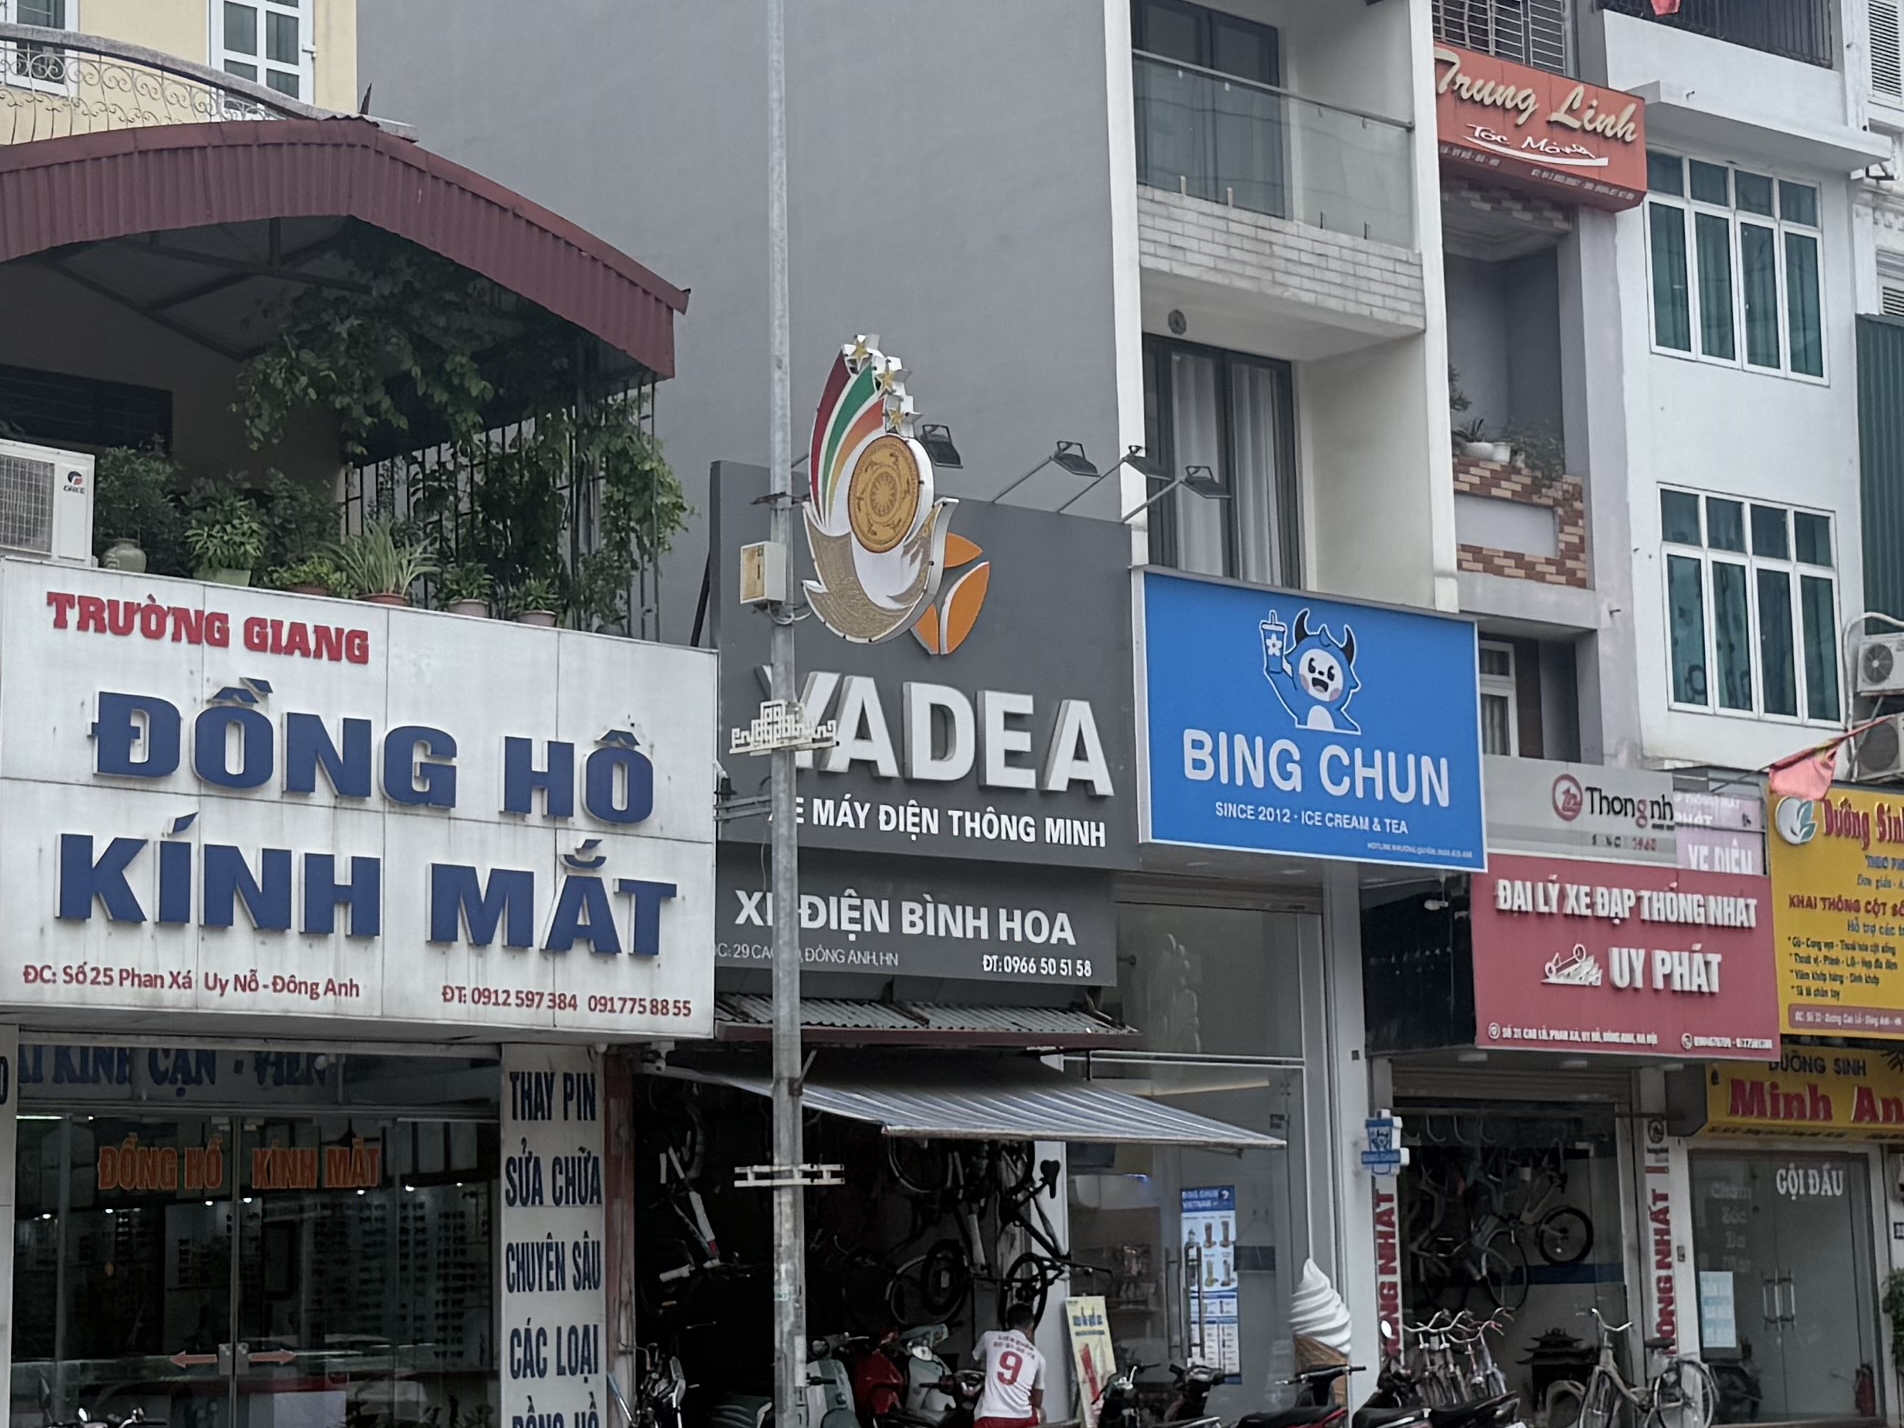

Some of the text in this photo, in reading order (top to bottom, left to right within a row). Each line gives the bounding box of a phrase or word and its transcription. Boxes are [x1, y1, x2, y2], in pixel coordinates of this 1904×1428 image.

[1434, 47, 1638, 143] Trung Linh
[46, 592, 370, 665] TRƯỜNG GIANG
[86, 677, 459, 810] ĐỒNG
[1183, 728, 1450, 808] BING CHUN
[813, 794, 1107, 848] MÁY ĐIỆN THÔNG MINH
[1215, 802, 1409, 834] SINCE 2012 ICE CREAM TEA
[54, 812, 678, 956] KÍNH MẮT
[1563, 883, 1636, 925] XE ĐẠP
[799, 889, 1077, 945] ĐIỆN BÌNH HOA
[23, 961, 360, 998] ĐC: Số 25 Phan Xá Uy Nỗ Anh
[1040, 958, 1092, 977] 50 51 58
[1609, 943, 1722, 993] UY PHÁT
[442, 985, 467, 1004] ĐT:
[471, 987, 512, 1008] 0912
[514, 990, 544, 1010] 597
[546, 992, 578, 1011] 384
[1833, 1057, 1867, 1077] SINH
[509, 1071, 596, 1122] THAY PIN
[1728, 1079, 1834, 1122] Minh
[505, 1137, 602, 1207] SỬA CHỮA
[1776, 1162, 1806, 1200] GỘI
[505, 1230, 601, 1294] CHUYÊN SÂU
[509, 1317, 599, 1384] CÁC LOẠI
[997, 1351, 1023, 1386] 9
